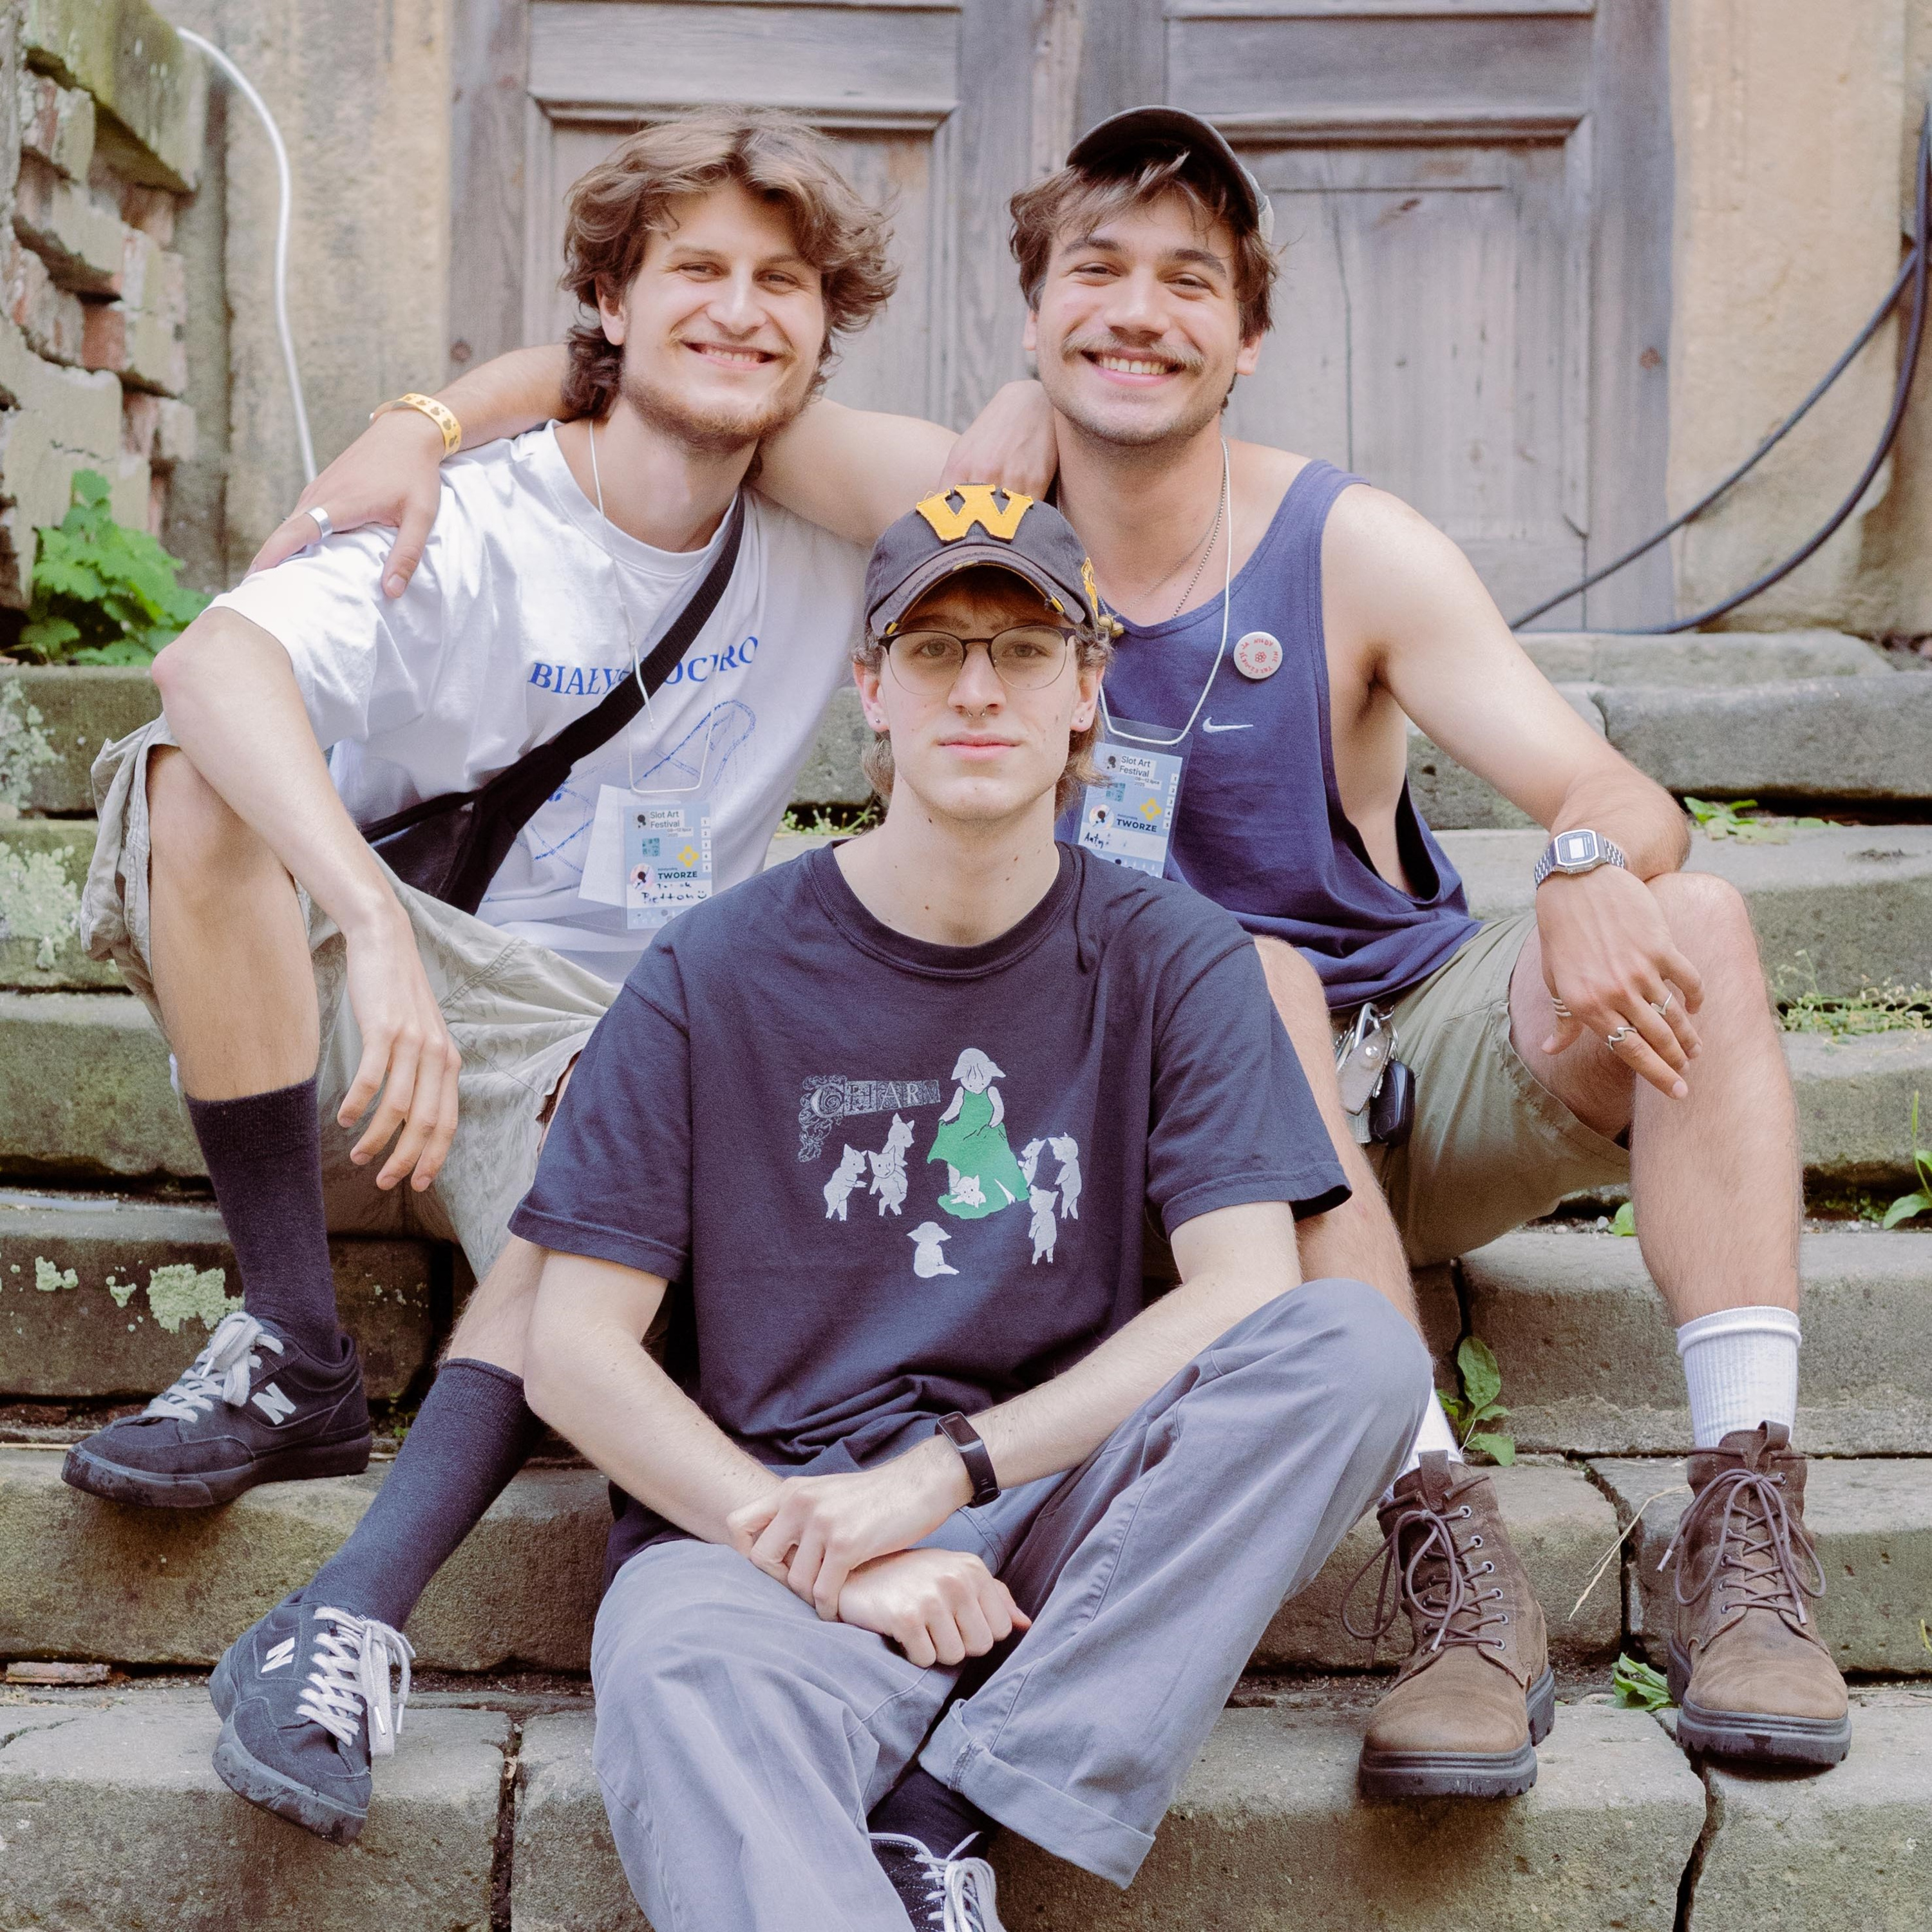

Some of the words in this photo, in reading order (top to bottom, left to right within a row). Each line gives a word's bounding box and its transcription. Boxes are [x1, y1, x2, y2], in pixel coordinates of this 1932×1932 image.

[916, 484, 1034, 542] W
[1121, 755, 1136, 765] Slot
[1119, 765, 1150, 777] Festival
[650, 820, 680, 828] Festival
[1117, 819, 1157, 832] TWORZE
[658, 871, 697, 879] TWORZE
[251, 1381, 297, 1425] N
[260, 1636, 295, 1674] N
